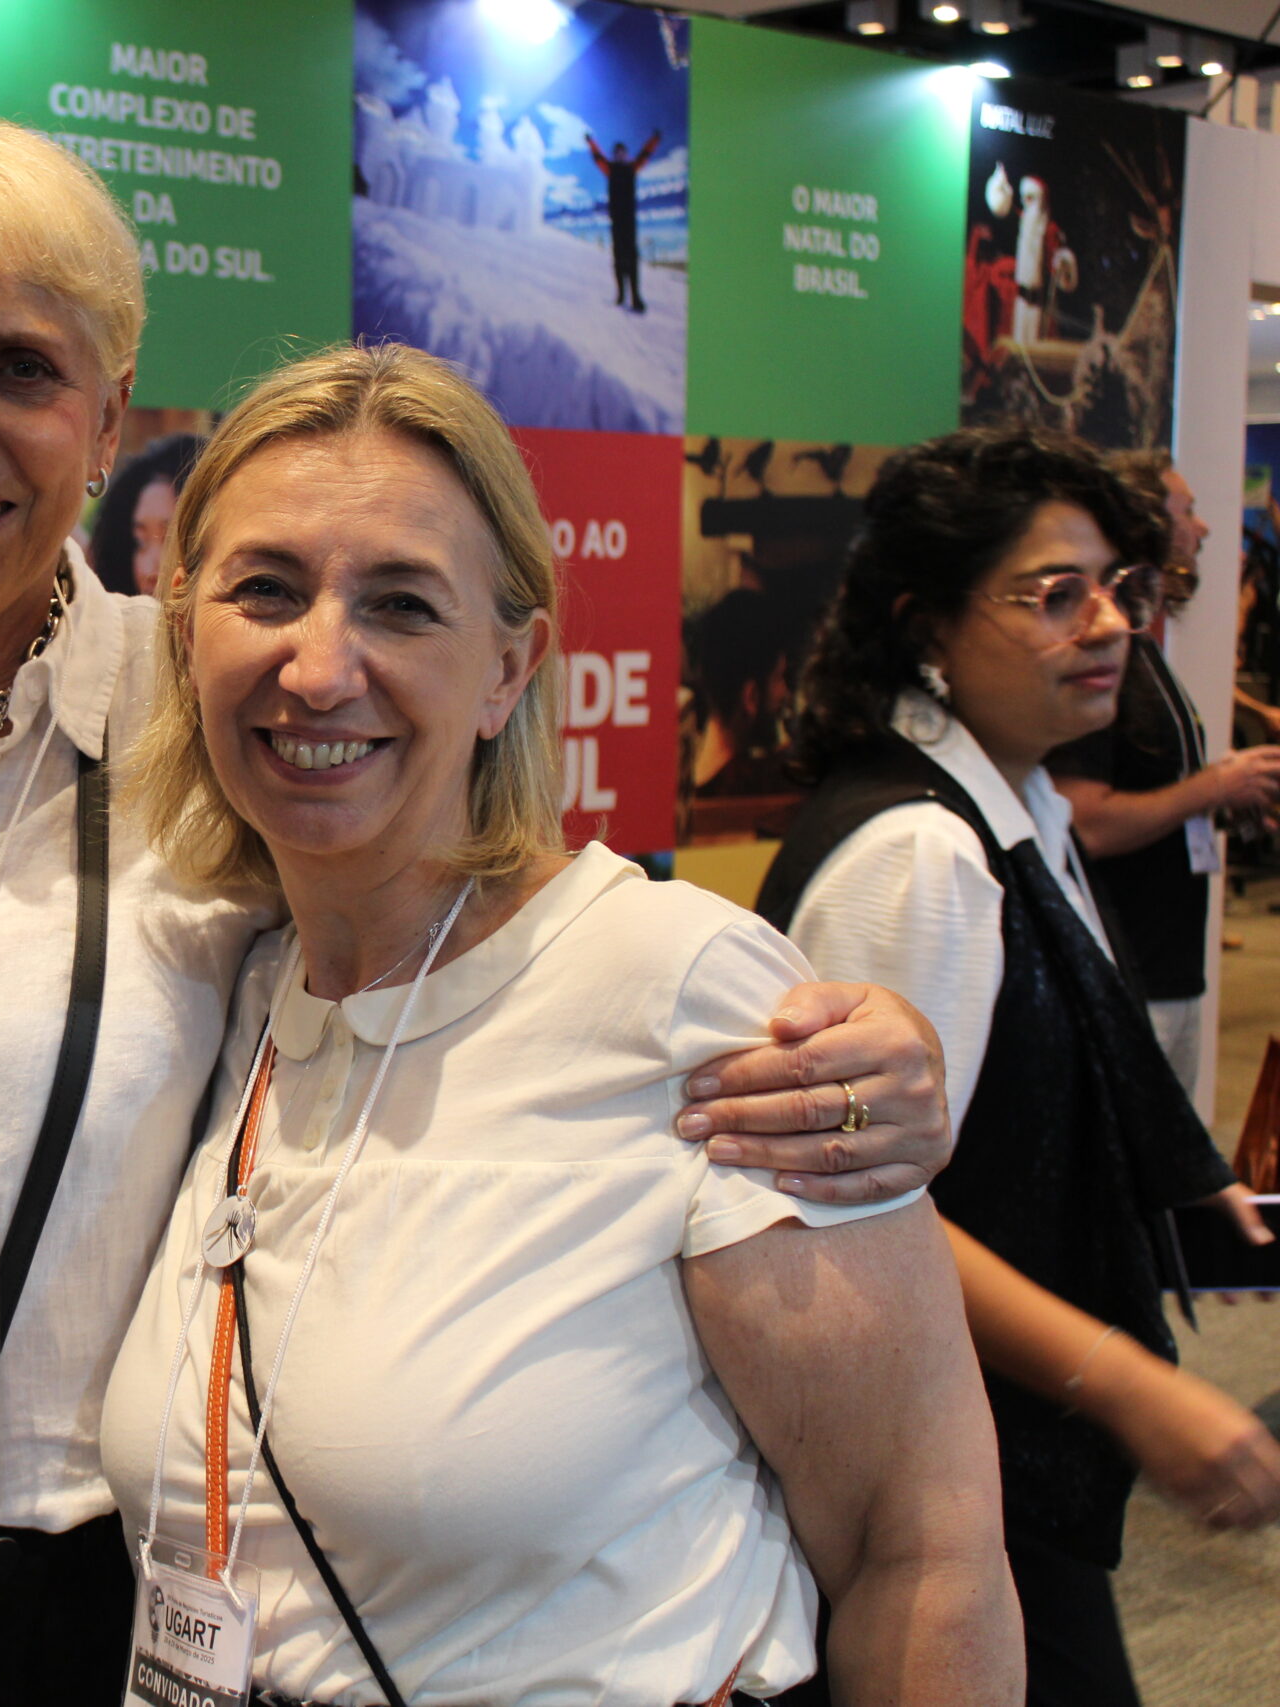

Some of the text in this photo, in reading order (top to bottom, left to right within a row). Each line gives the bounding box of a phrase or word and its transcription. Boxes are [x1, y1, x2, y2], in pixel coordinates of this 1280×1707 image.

[110, 42, 208, 86] MAIOR
[49, 83, 257, 140] COMPLEXO DE
[28, 129, 281, 189] TRETENIMENTO
[134, 191, 176, 225] DA
[792, 185, 878, 224] O MAIOR
[166, 242, 208, 275] DO
[215, 247, 274, 282] SUL.
[783, 223, 880, 262] NATAL DO
[794, 263, 869, 299] BRASIL.
[581, 520, 627, 559] AO
[165, 1605, 221, 1649] UGART
[200, 1654, 215, 1665] 2025
